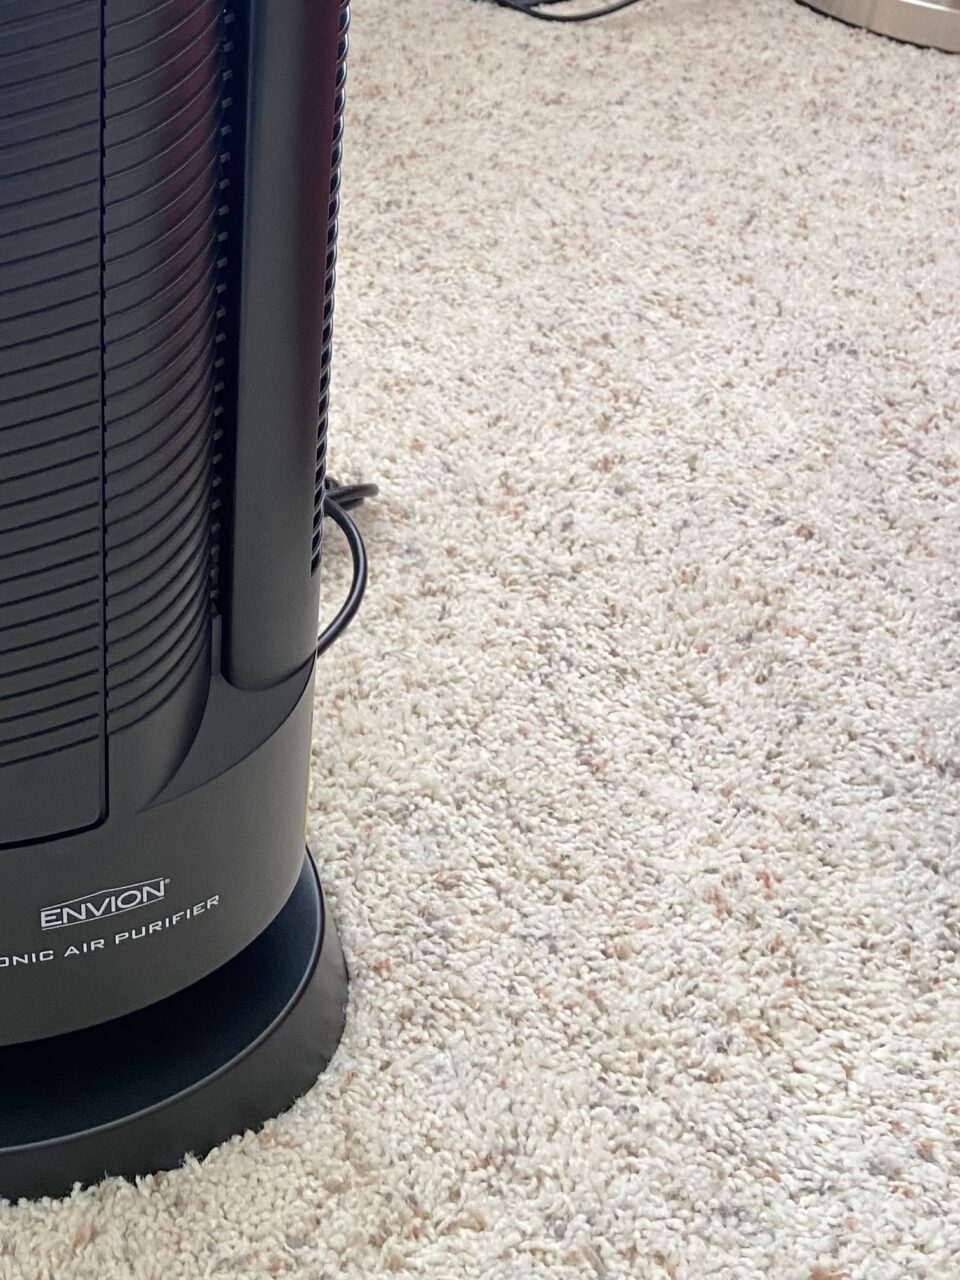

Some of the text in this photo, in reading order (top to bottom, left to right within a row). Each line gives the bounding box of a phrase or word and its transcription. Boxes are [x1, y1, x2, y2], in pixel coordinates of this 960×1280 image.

[40, 880, 165, 928] ENVION
[64, 939, 105, 957] AIR
[115, 894, 220, 945] PURIFIER
